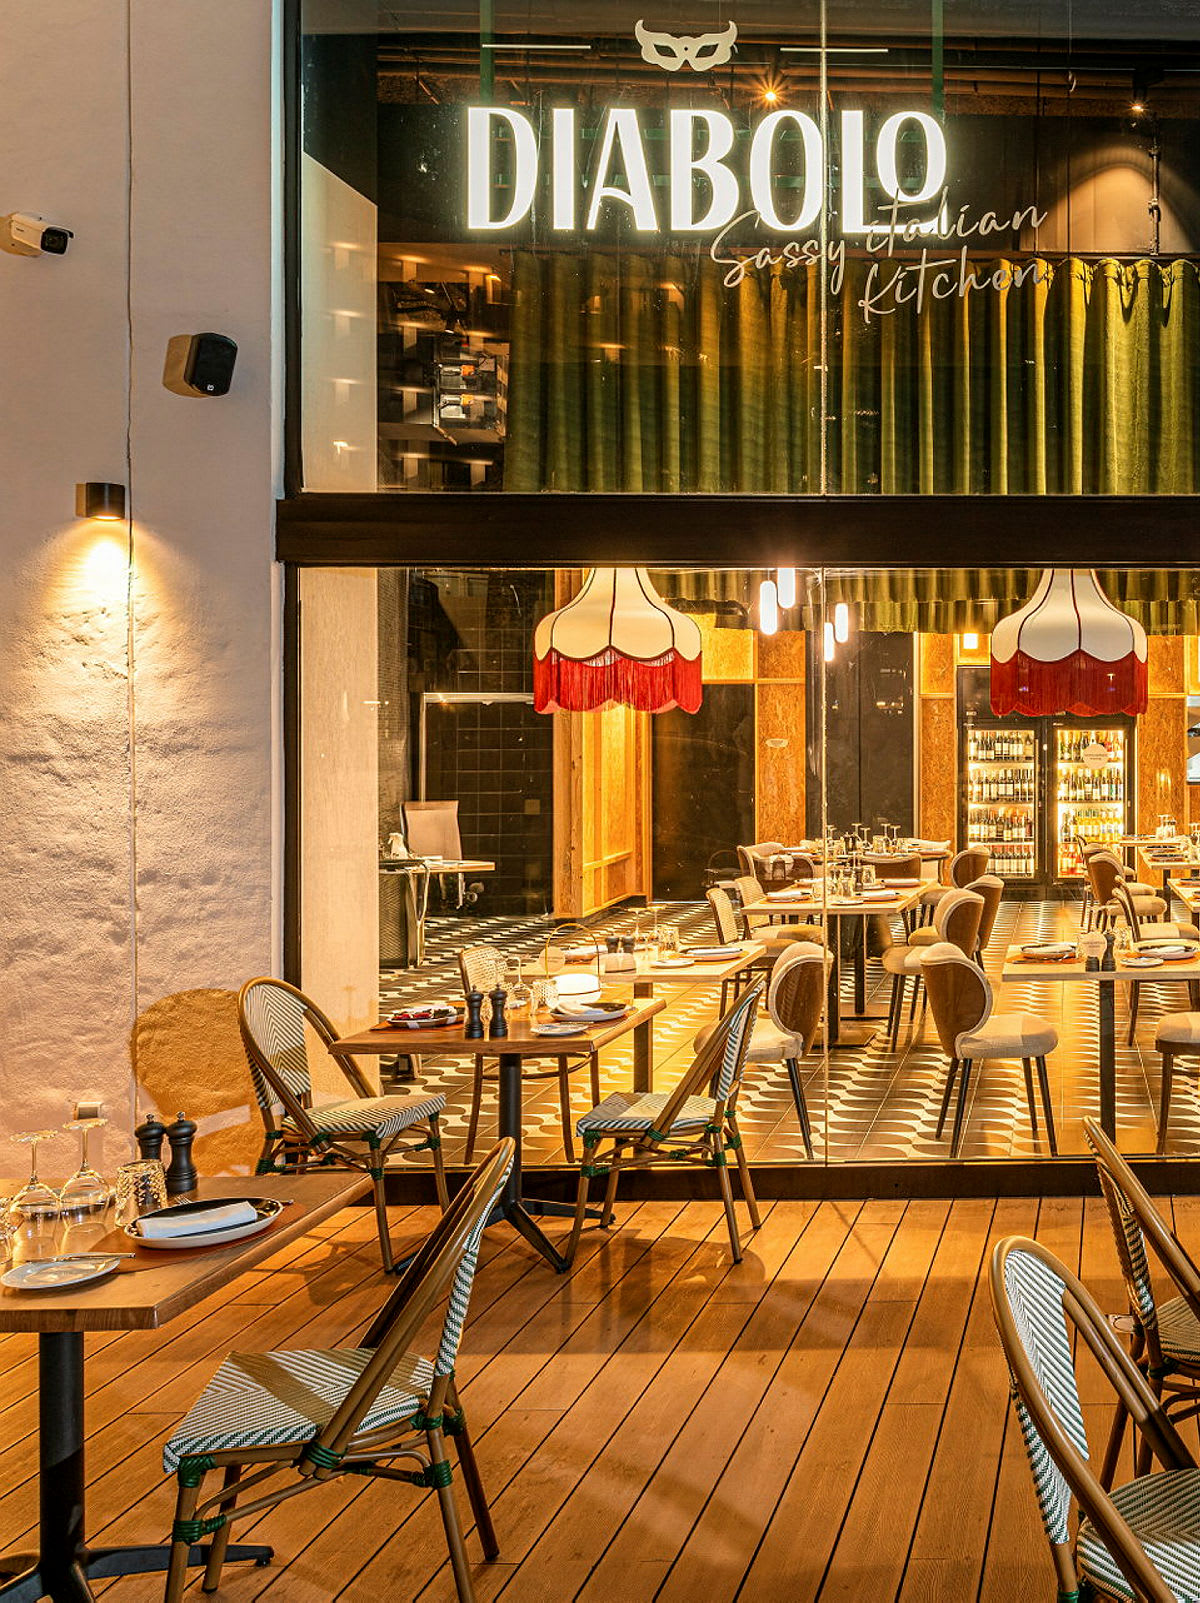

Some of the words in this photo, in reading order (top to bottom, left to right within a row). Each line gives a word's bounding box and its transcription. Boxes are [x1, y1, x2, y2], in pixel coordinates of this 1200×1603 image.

[467, 105, 947, 234] DIABOLO
[710, 209, 845, 295] Sassy
[858, 245, 1055, 324] Kitchen
